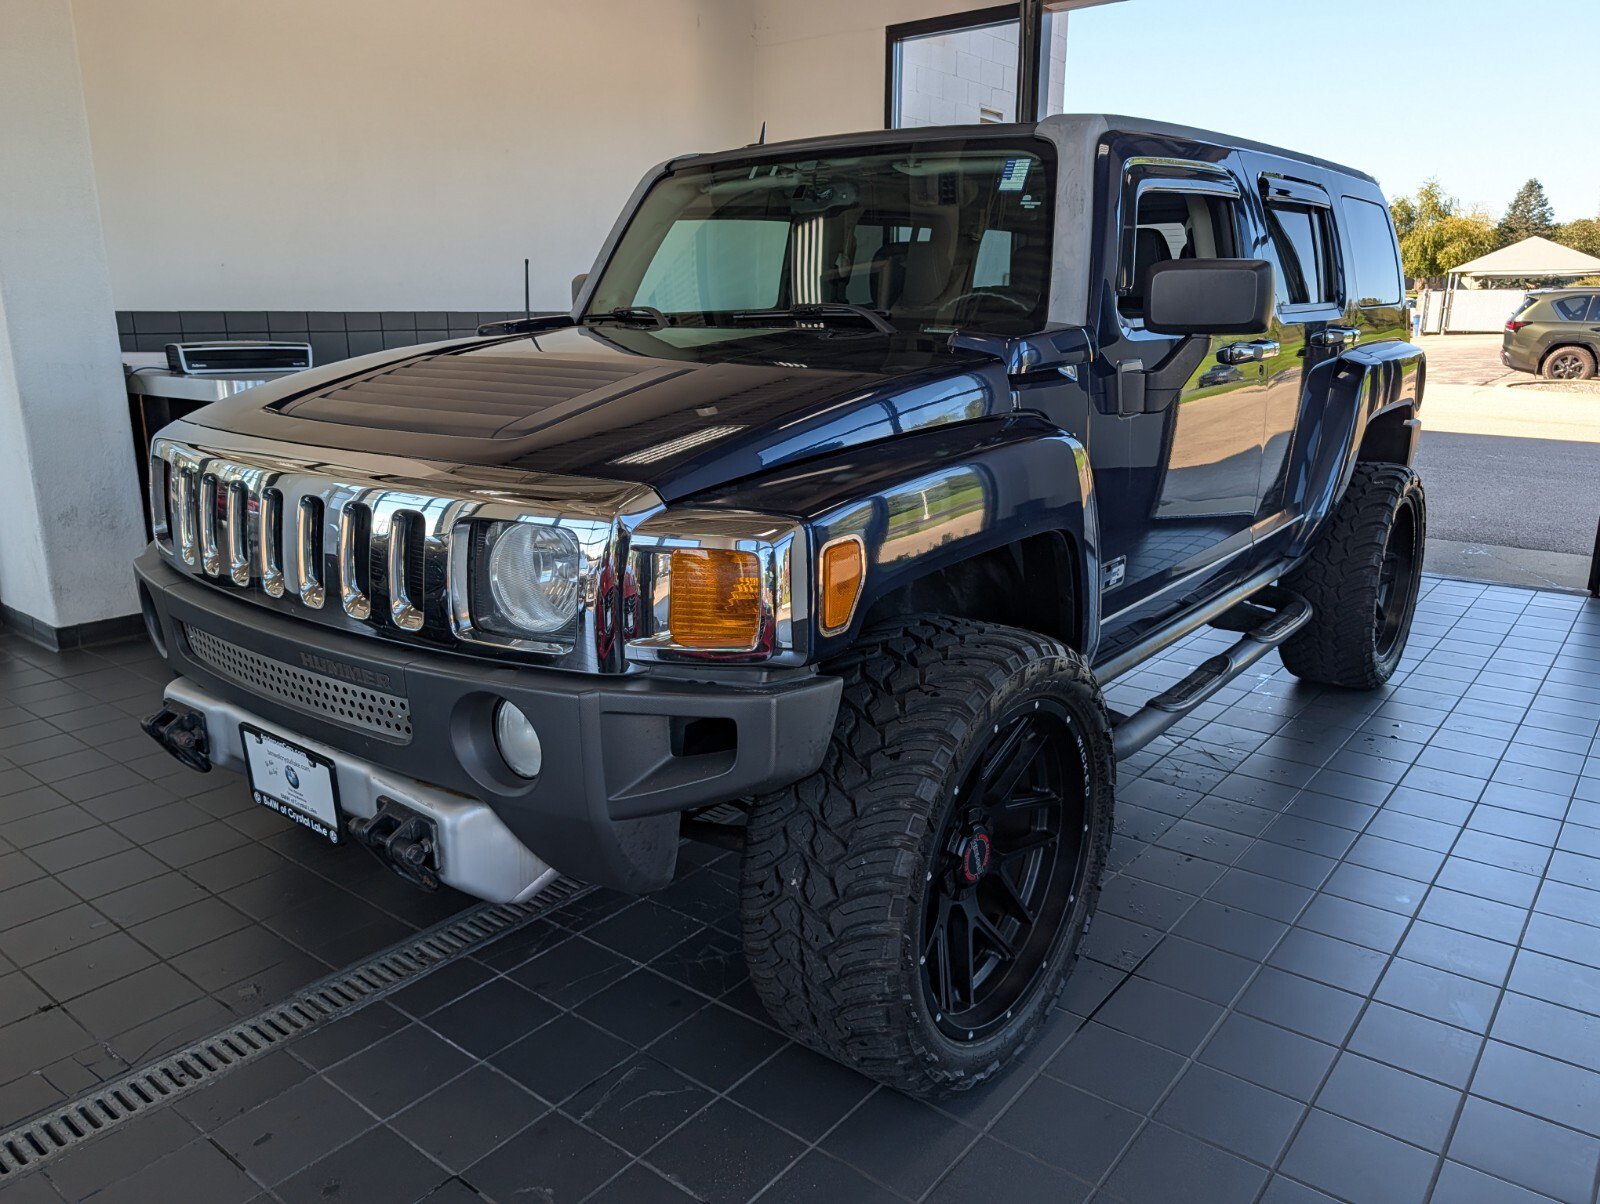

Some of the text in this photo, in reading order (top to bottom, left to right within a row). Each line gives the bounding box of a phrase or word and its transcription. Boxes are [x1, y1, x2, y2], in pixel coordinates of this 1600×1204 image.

[299, 651, 392, 691] HUMMER
[1077, 735, 1090, 797] WICKED
[263, 795, 279, 811] BMW
[288, 808, 311, 828] Crystal
[311, 820, 328, 836] Lake
